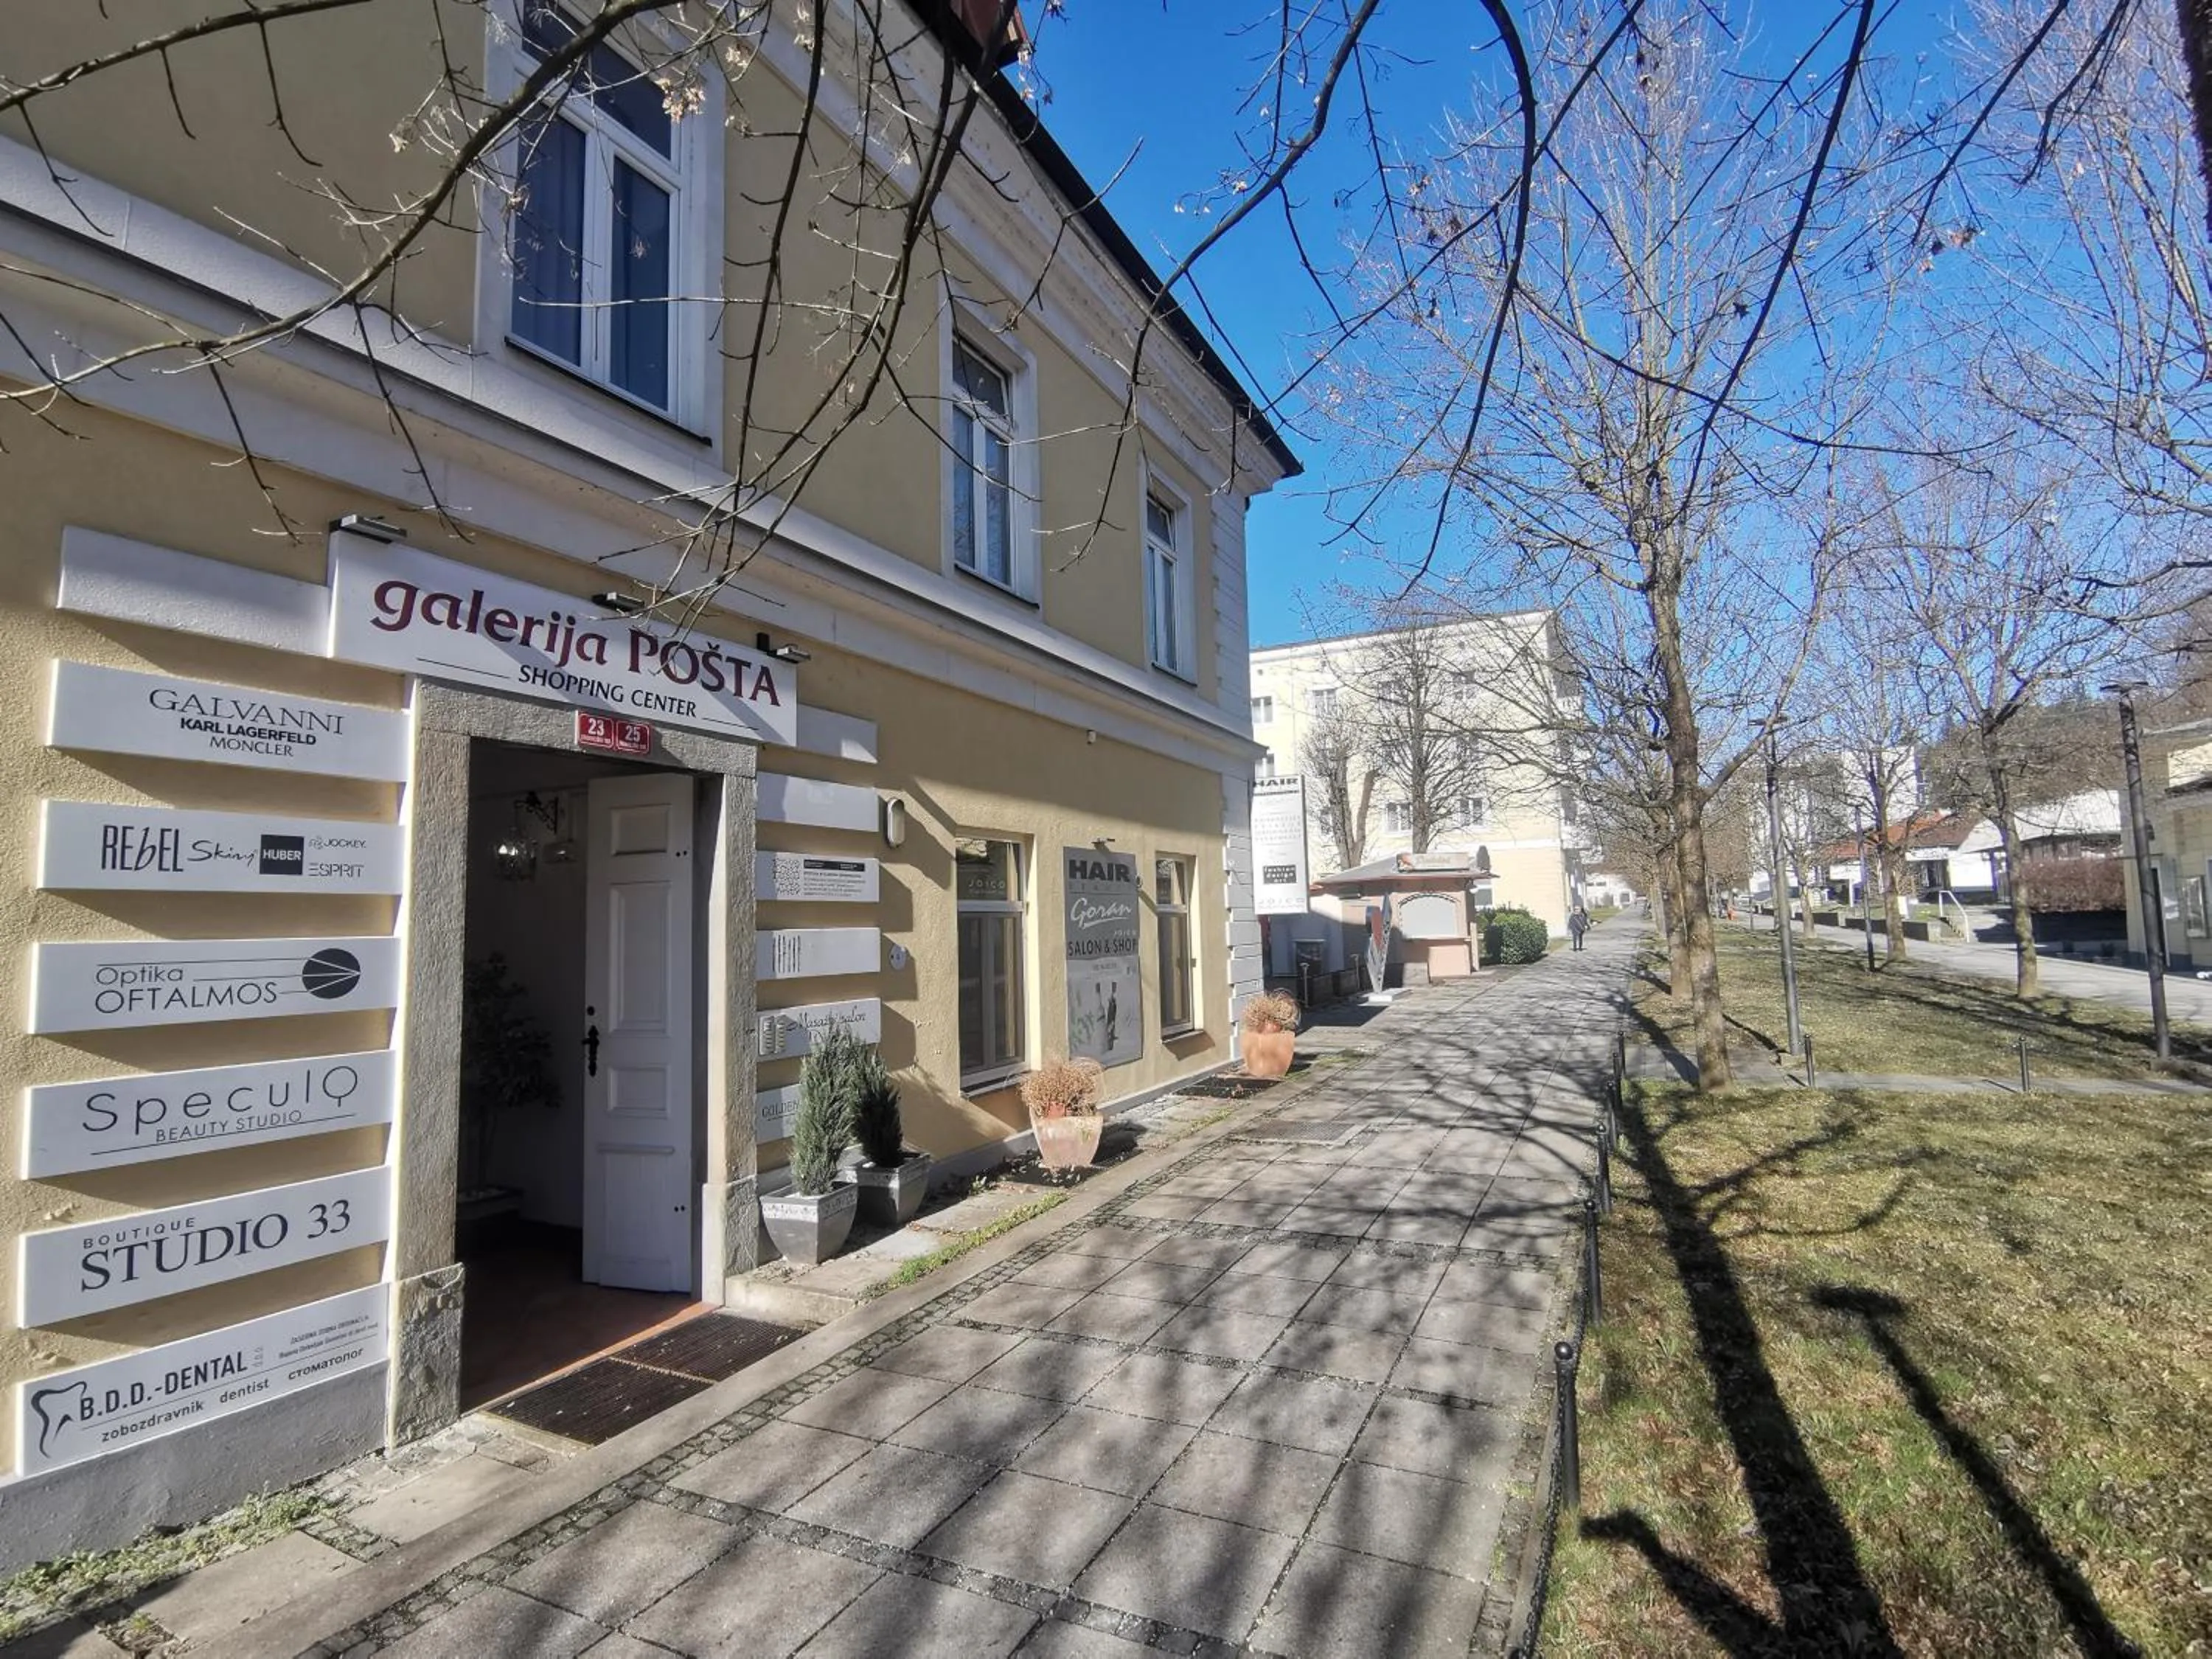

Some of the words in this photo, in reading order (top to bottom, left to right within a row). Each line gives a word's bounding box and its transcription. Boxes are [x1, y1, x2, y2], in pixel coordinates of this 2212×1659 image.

[370, 581, 608, 667] galerija
[628, 627, 780, 706] POŠTA
[518, 665, 624, 702] SHOPPING
[631, 690, 696, 717] CENTER
[149, 689, 344, 735] GALVANNI
[180, 717, 224, 734] KARL
[227, 723, 316, 745] LAGERFELD
[588, 718, 605, 737] 23
[625, 725, 641, 742] 25
[209, 737, 293, 757] MONCLER
[1253, 778, 1298, 787] HAIR
[263, 849, 302, 861] HUBER
[309, 862, 364, 877] ESPRIT
[1069, 860, 1130, 882] HAIR
[1071, 897, 1133, 929] Goran
[1068, 940, 1102, 956] SALON
[1105, 942, 1110, 954] &
[96, 966, 183, 988] Optika
[95, 981, 277, 1014] OFTALMOS
[156, 1120, 229, 1142] BEAUTY
[236, 1110, 302, 1131] STUDIO
[80, 1213, 288, 1292] STUDIO
[307, 1199, 350, 1239] 33
[83, 1217, 195, 1249] BOUTIQUE
[102, 1400, 204, 1442] zobozdravnik
[219, 1378, 270, 1403] dentist
